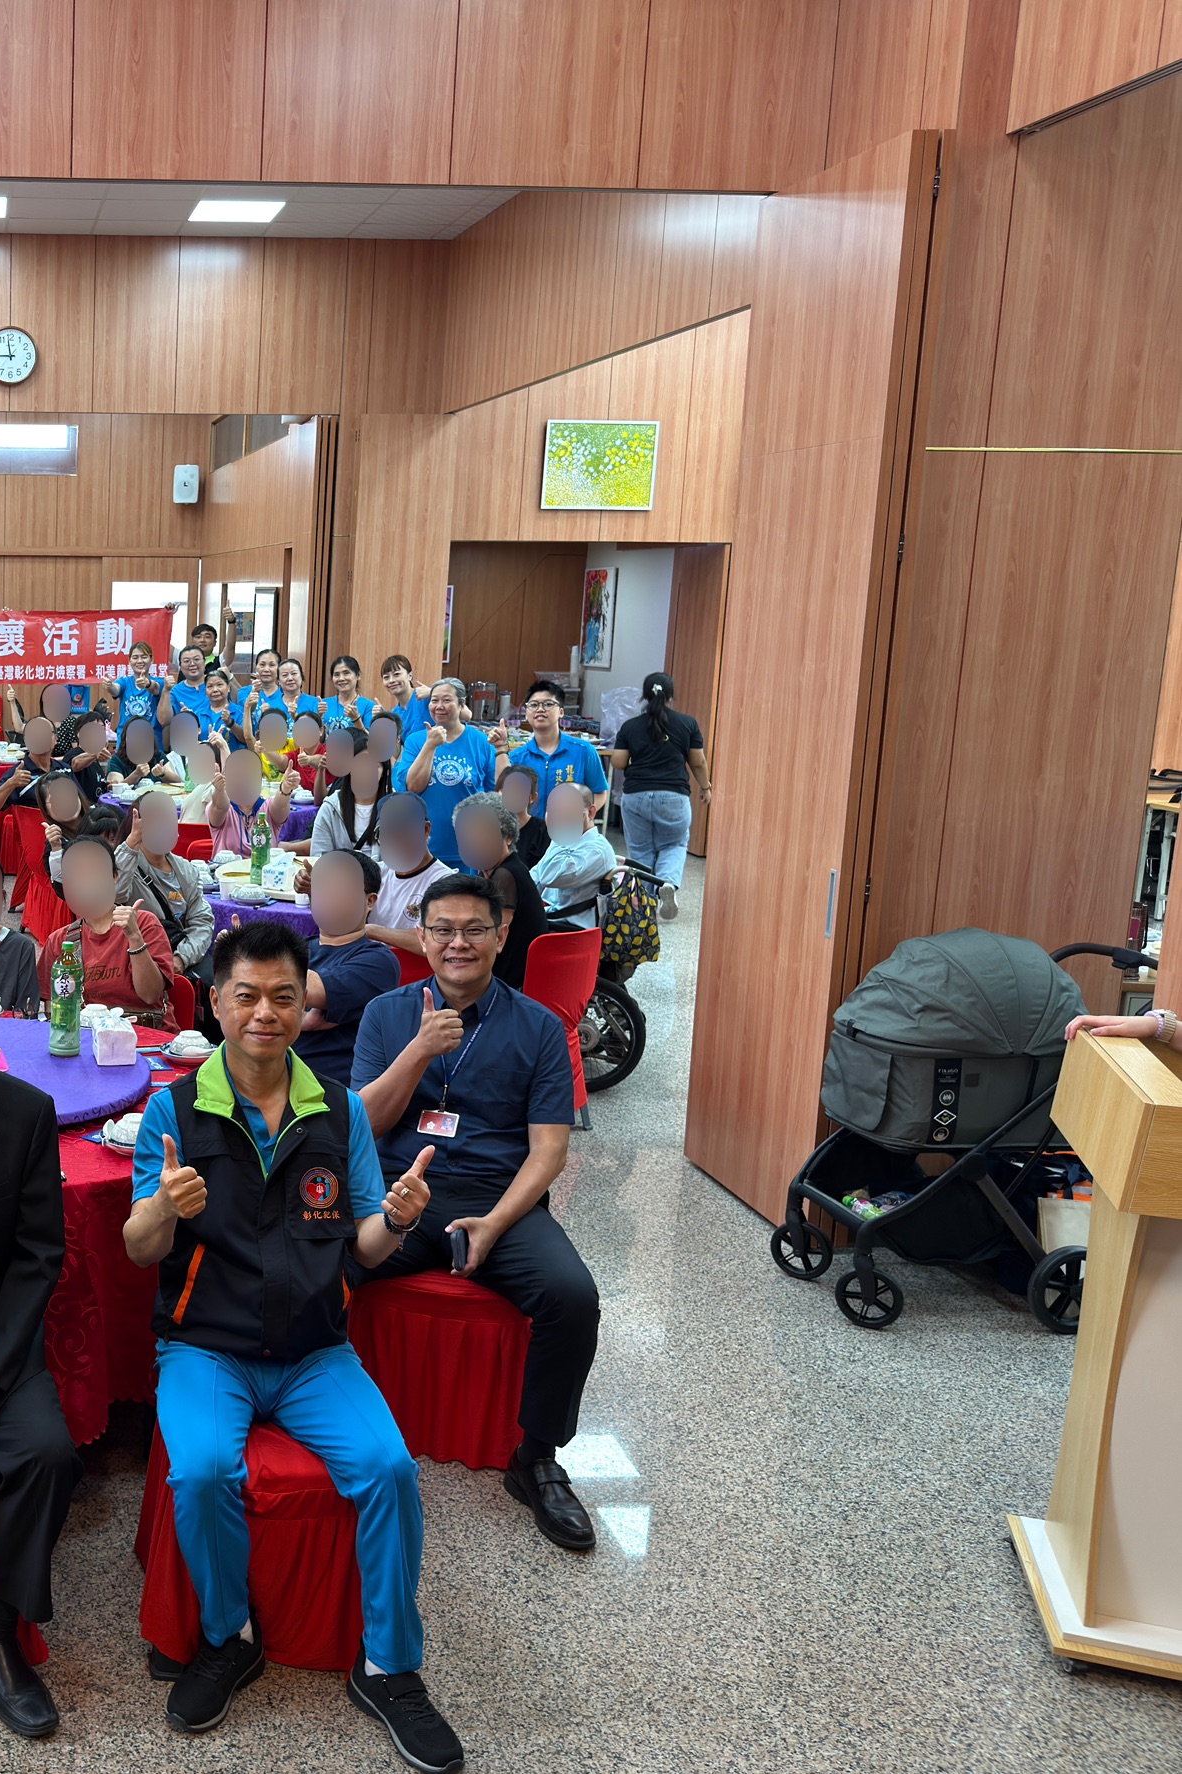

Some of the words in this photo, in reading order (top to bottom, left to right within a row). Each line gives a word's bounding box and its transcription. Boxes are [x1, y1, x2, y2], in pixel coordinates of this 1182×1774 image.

[23, 343, 28, 351] 2
[26, 352, 31, 360] 3
[0, 368, 5, 376] 7
[8, 371, 13, 379] 6
[16, 368, 21, 376] 5
[56, 972, 71, 1000] 原萃
